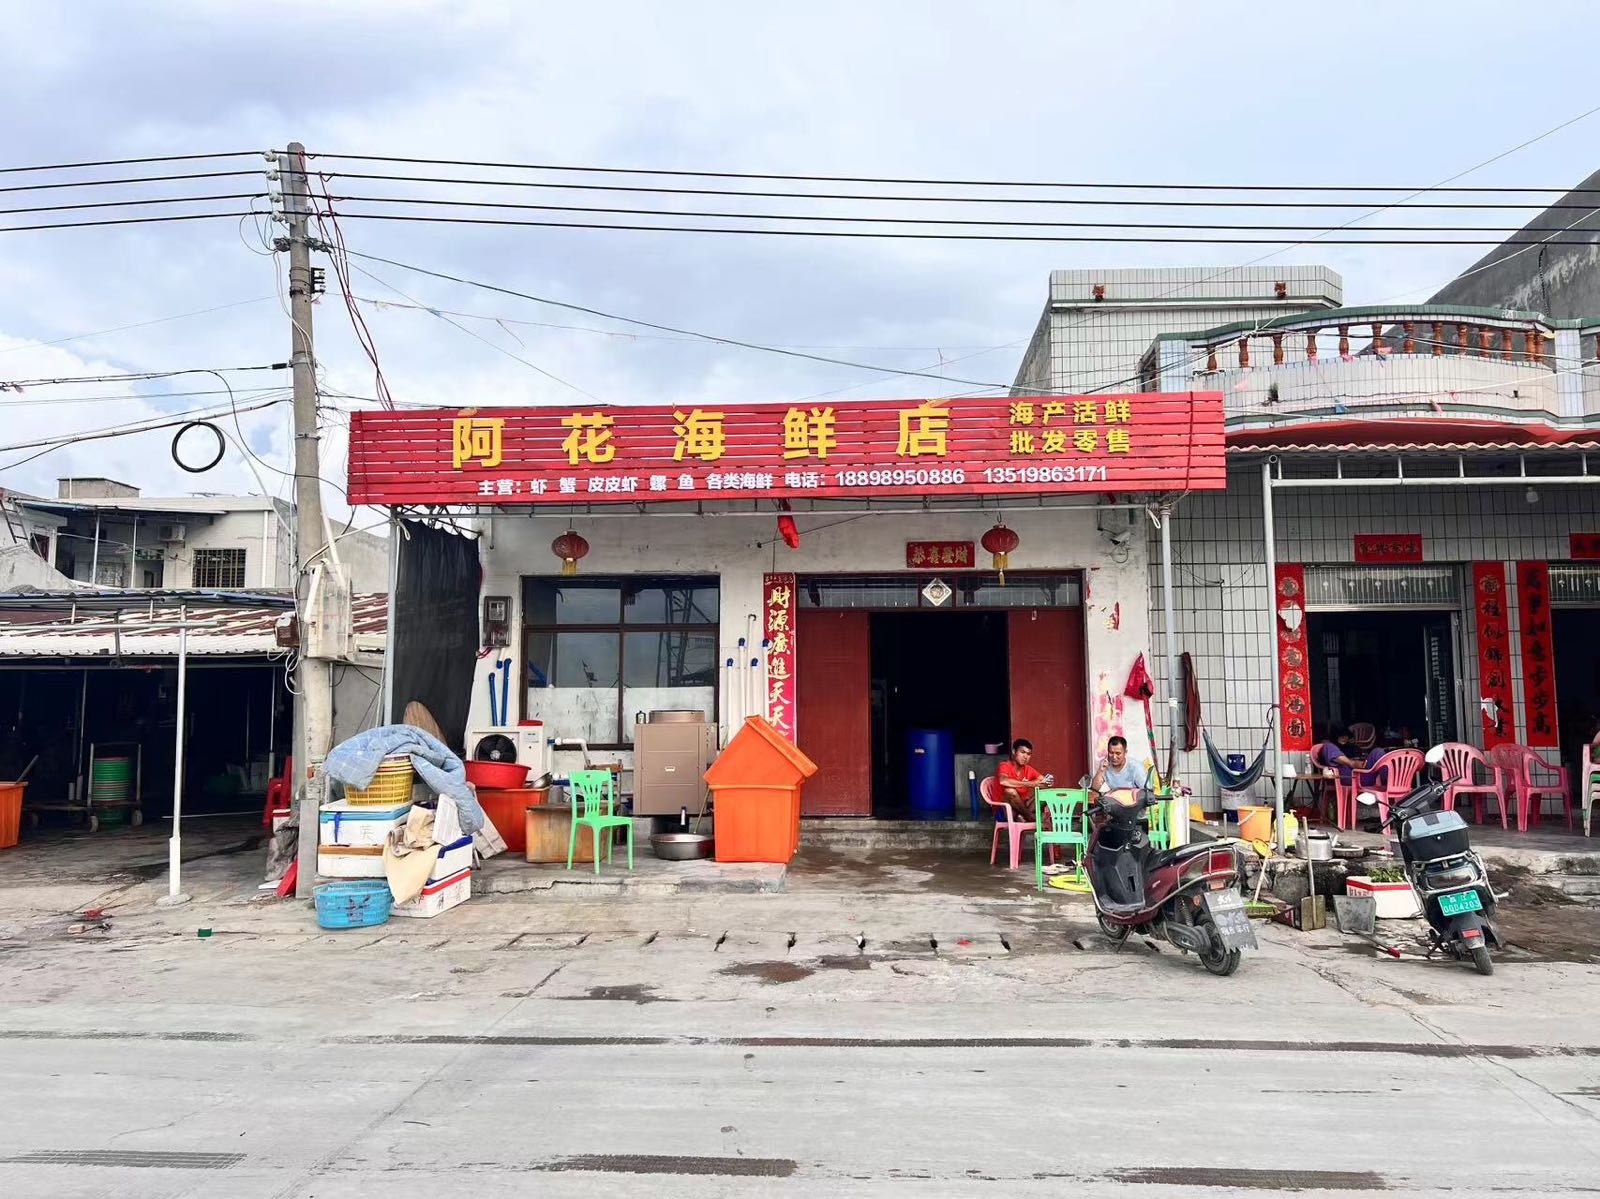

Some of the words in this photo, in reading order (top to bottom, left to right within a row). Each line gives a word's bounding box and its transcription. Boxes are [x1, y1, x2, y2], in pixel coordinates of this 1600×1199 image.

[1009, 399, 1131, 425] 海产活鲜
[452, 400, 950, 468] 阿花海鲜店
[1009, 428, 1131, 454] 批发零售
[559, 477, 577, 494] 蟹
[587, 475, 638, 492] 皮皮虾
[650, 474, 668, 491] 螺
[677, 473, 695, 490] 鱼
[706, 471, 774, 490] 各类海鲜
[835, 469, 966, 487] 18898950886
[983, 465, 1107, 484] 13519863171
[767, 585, 791, 736] 財源廣進天天
